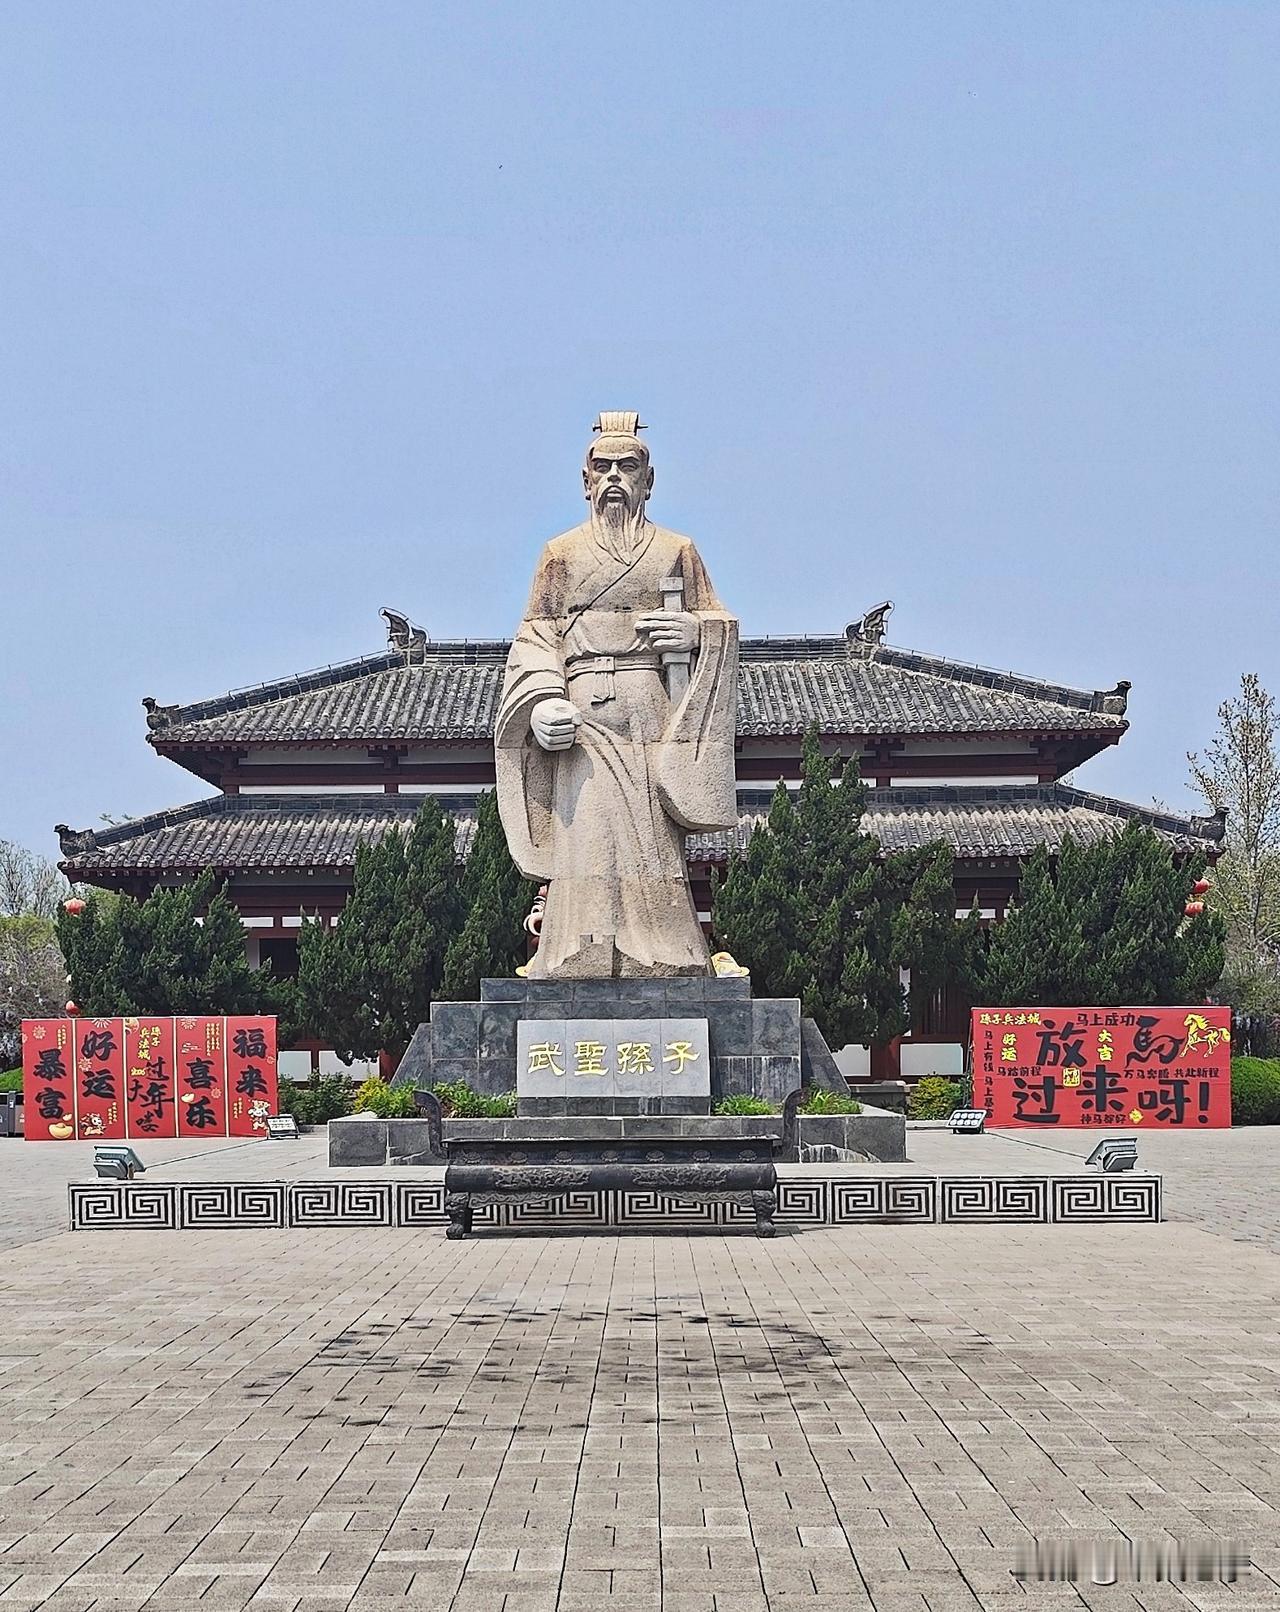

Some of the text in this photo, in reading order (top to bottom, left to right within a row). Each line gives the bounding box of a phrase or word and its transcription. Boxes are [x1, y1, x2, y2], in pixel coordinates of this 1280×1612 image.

[1076, 1013, 1135, 1026] 马上成功
[1096, 1029, 1114, 1062] 大吉
[81, 1030, 117, 1099] 好运
[232, 1028, 268, 1097] 福来
[527, 1041, 701, 1077] 武聖孫子
[1001, 1033, 1017, 1062] 好运
[33, 1048, 68, 1119] 暴富
[183, 1056, 218, 1129] 喜乐
